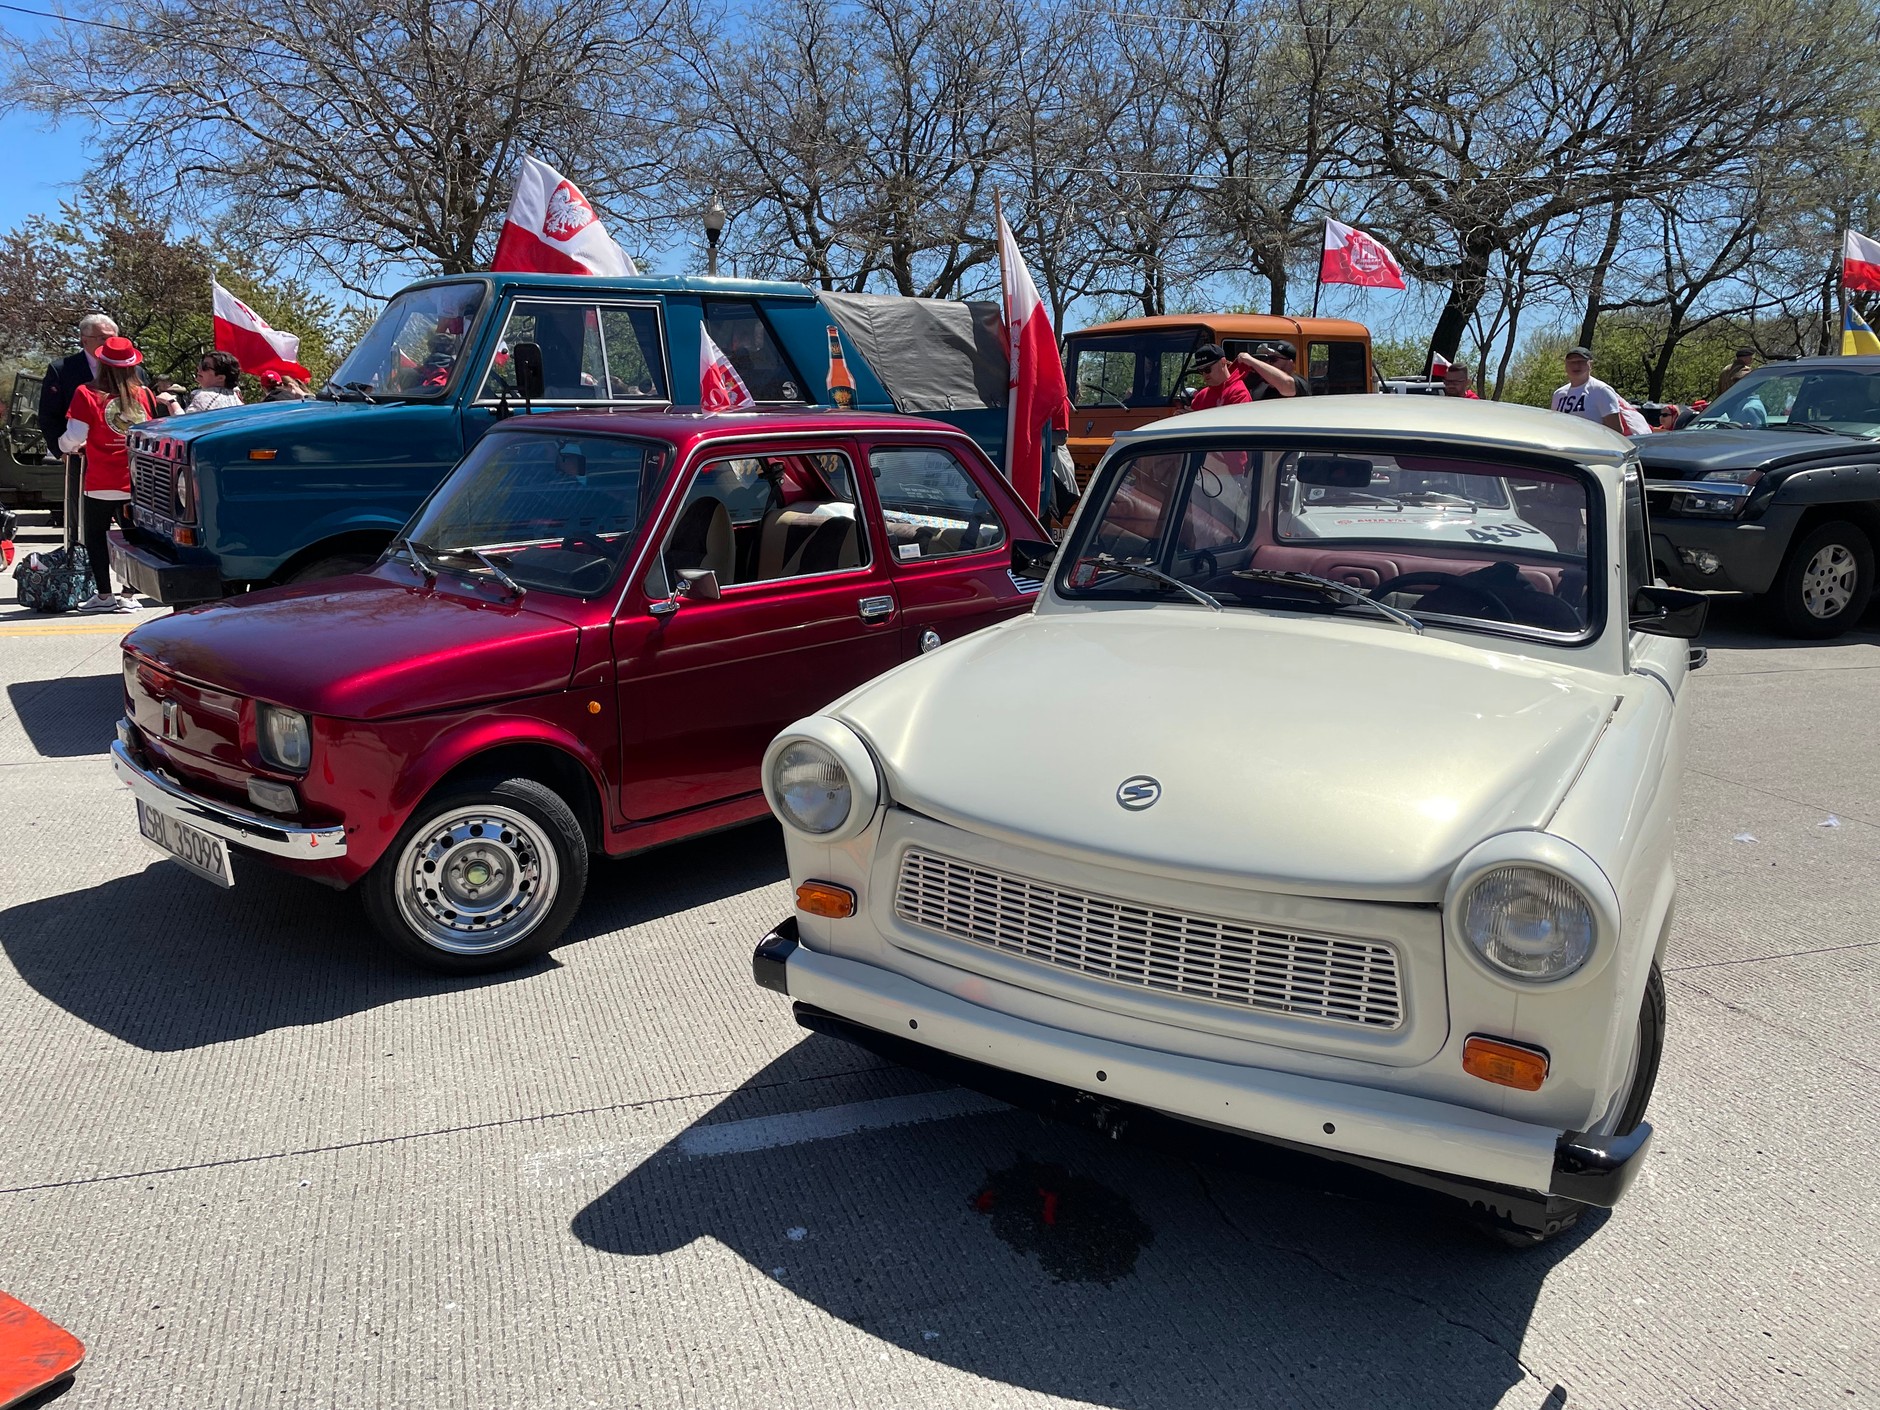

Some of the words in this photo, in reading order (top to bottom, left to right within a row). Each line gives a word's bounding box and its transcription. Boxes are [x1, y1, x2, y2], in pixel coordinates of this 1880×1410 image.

[1556, 395, 1586, 413] USA
[1465, 523, 1540, 544] 430
[145, 805, 173, 850] SBL
[174, 822, 223, 874] 35099
